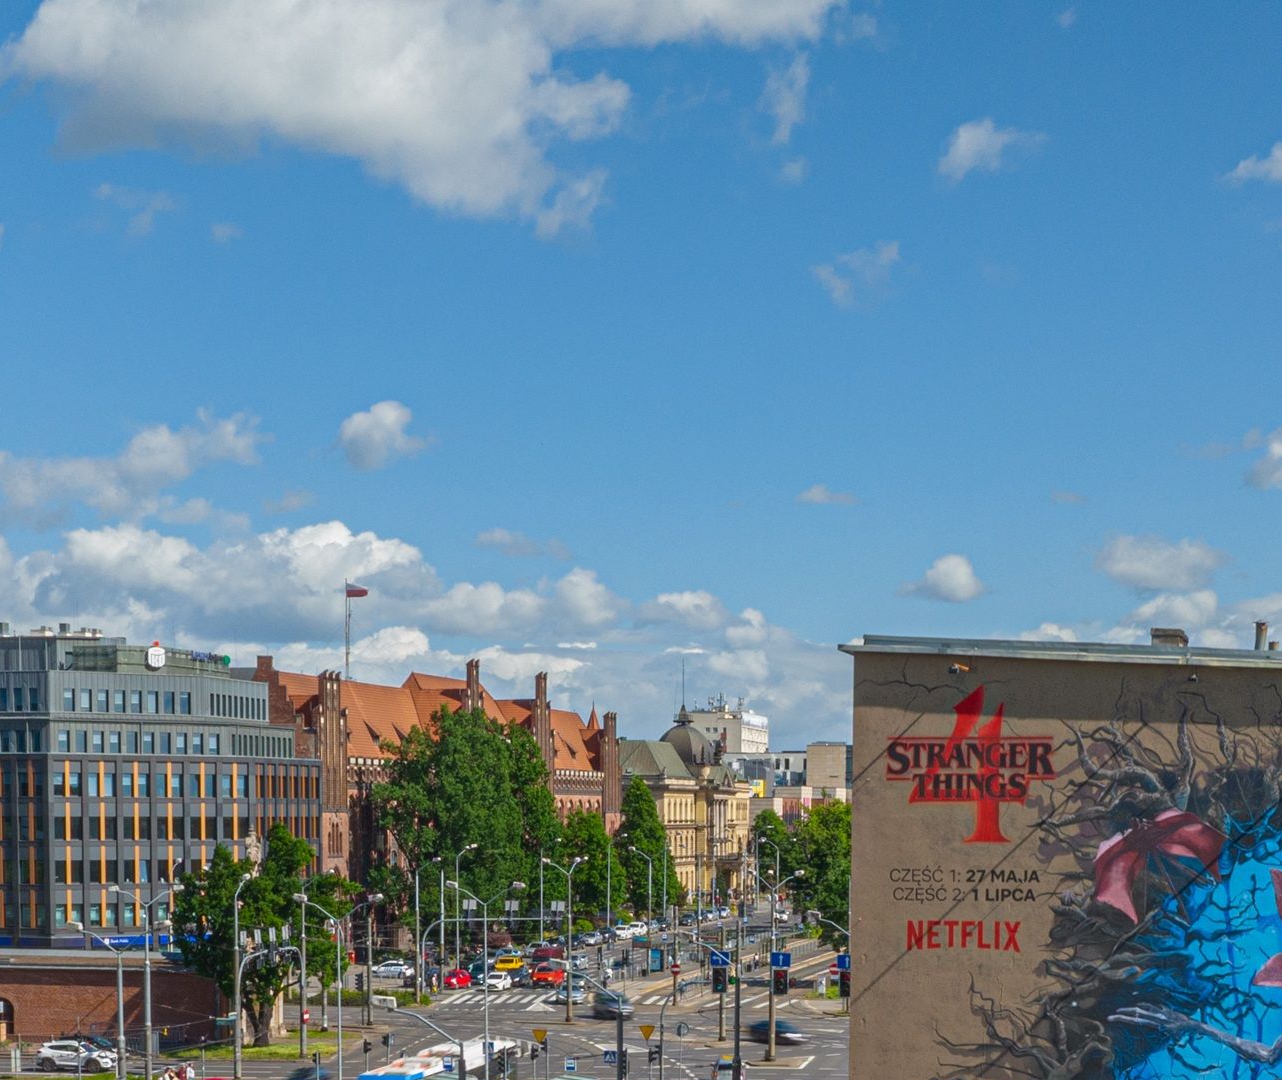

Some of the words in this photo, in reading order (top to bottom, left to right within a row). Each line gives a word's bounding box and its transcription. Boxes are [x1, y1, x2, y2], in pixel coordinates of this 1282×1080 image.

[887, 742, 1057, 776] STRANGER
[912, 773, 1027, 800] THINGS
[889, 865, 944, 886] CZĘŚĆ
[950, 869, 961, 883] 1:
[966, 869, 986, 883] 27
[991, 869, 1040, 883] MAJA
[893, 885, 947, 904] CZĘŚĆ
[952, 888, 966, 902] 2:
[972, 888, 979, 902] 1
[985, 888, 1036, 902] LIPCA
[907, 919, 1021, 953] NETFLIX
